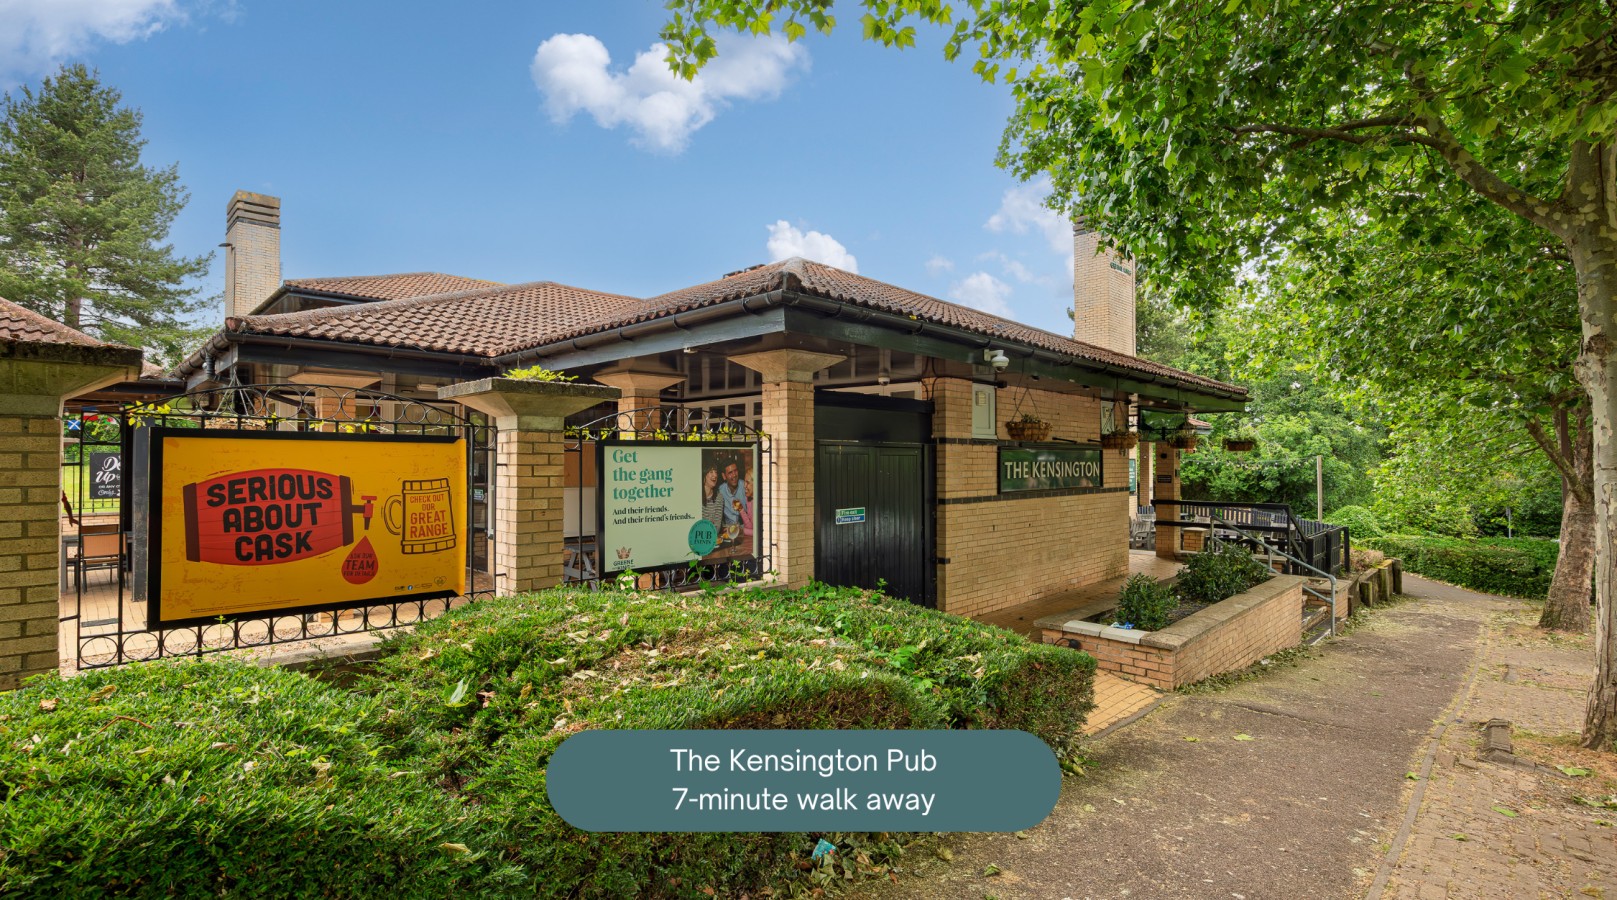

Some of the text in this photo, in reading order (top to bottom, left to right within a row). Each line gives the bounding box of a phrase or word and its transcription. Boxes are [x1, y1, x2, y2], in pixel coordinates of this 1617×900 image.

[612, 449, 638, 464] Get
[612, 467, 673, 485] the gang
[1004, 461, 1100, 479] THE KENSINGTON
[206, 473, 333, 508] SERIOUS
[612, 484, 674, 503] together
[409, 493, 445, 504] CHECK OUT
[421, 503, 436, 511] OUR
[612, 505, 670, 516] And their friends.
[222, 502, 322, 533] ABOUT
[410, 510, 447, 525] GREAT
[612, 516, 626, 526] And
[627, 516, 644, 525] their
[644, 514, 669, 522] friend's
[409, 522, 449, 539] RANGE
[694, 530, 712, 540] PUB
[235, 530, 314, 562] CASK
[345, 559, 375, 571] TEAM
[613, 559, 634, 567] GREENE
